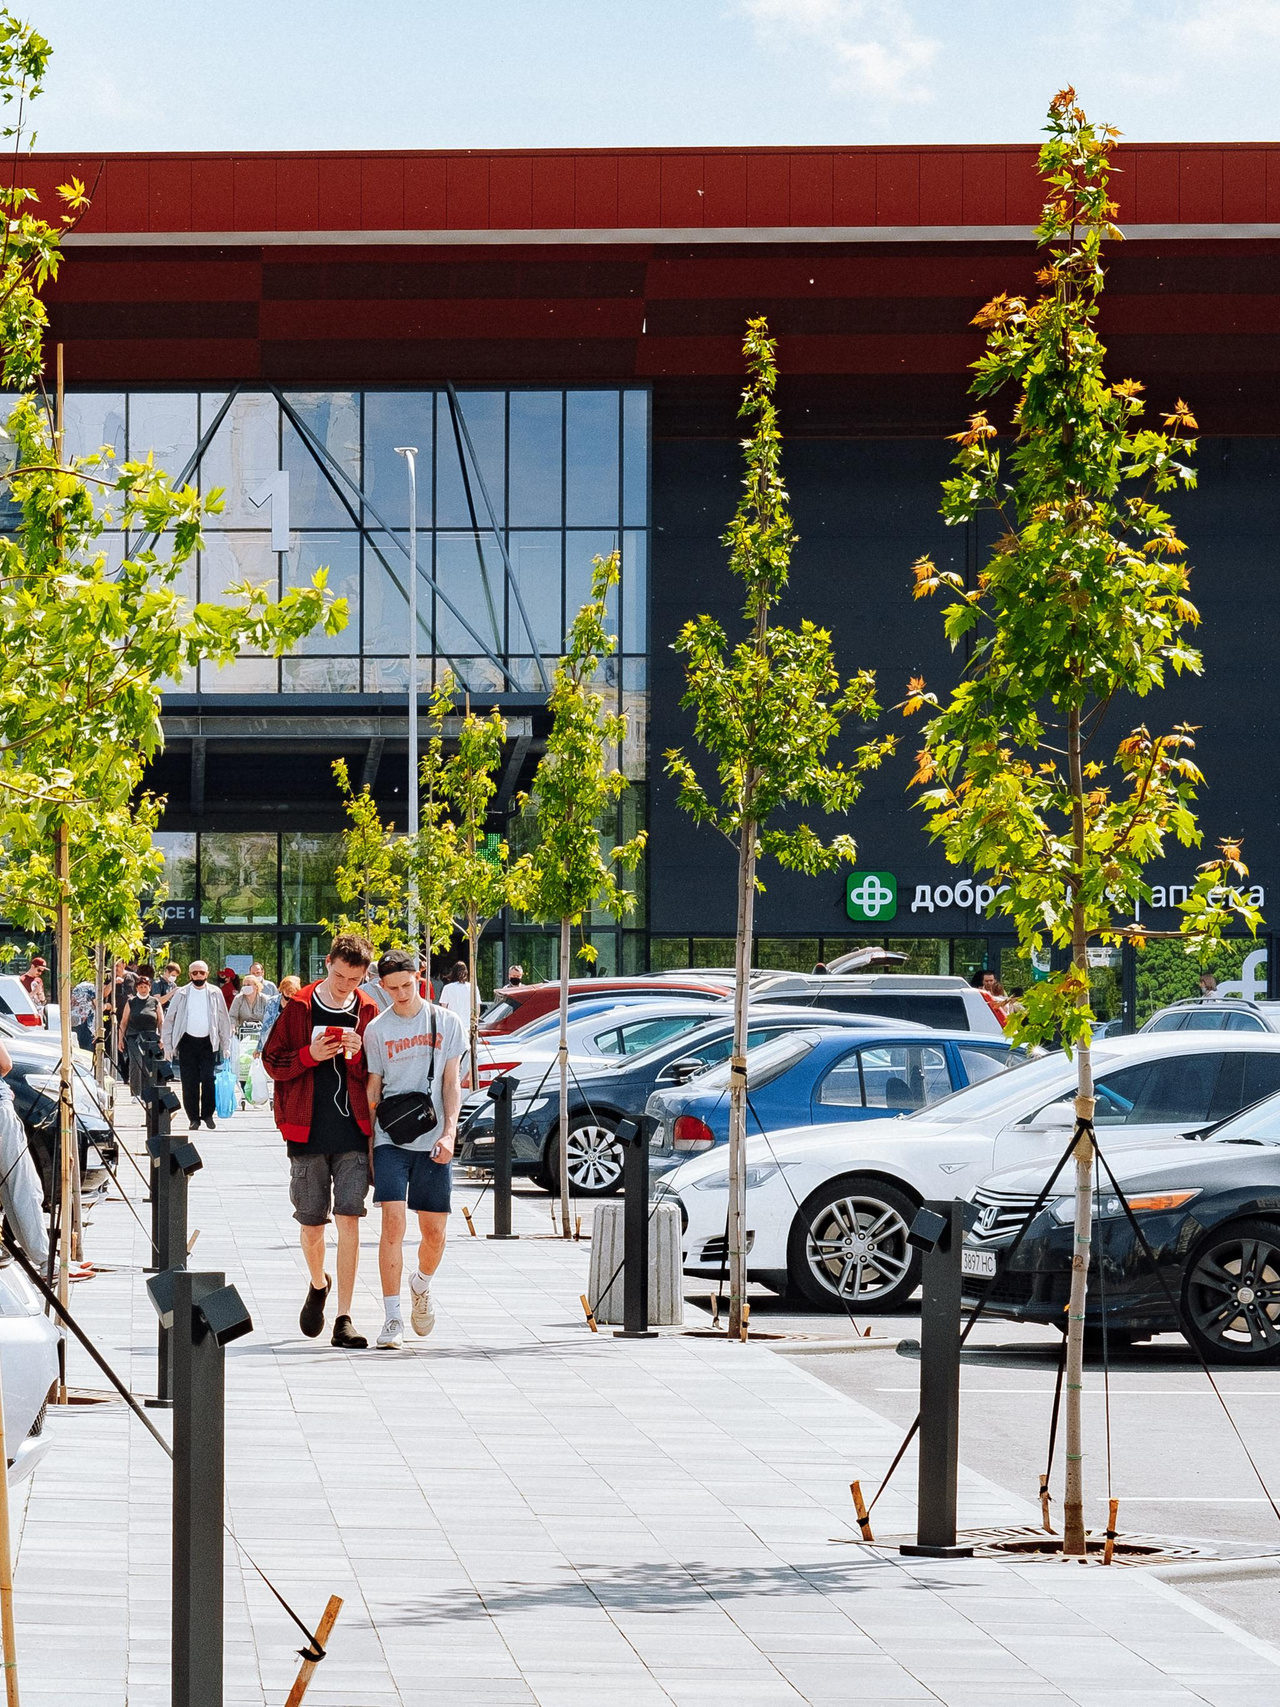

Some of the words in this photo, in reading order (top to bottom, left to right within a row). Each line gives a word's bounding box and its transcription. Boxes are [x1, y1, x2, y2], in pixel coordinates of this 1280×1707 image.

[249, 470, 290, 552] 1
[1151, 885, 1265, 907] апека
[188, 907, 195, 919] 1
[963, 1253, 980, 1271] 3897
[981, 1256, 994, 1273] HC
